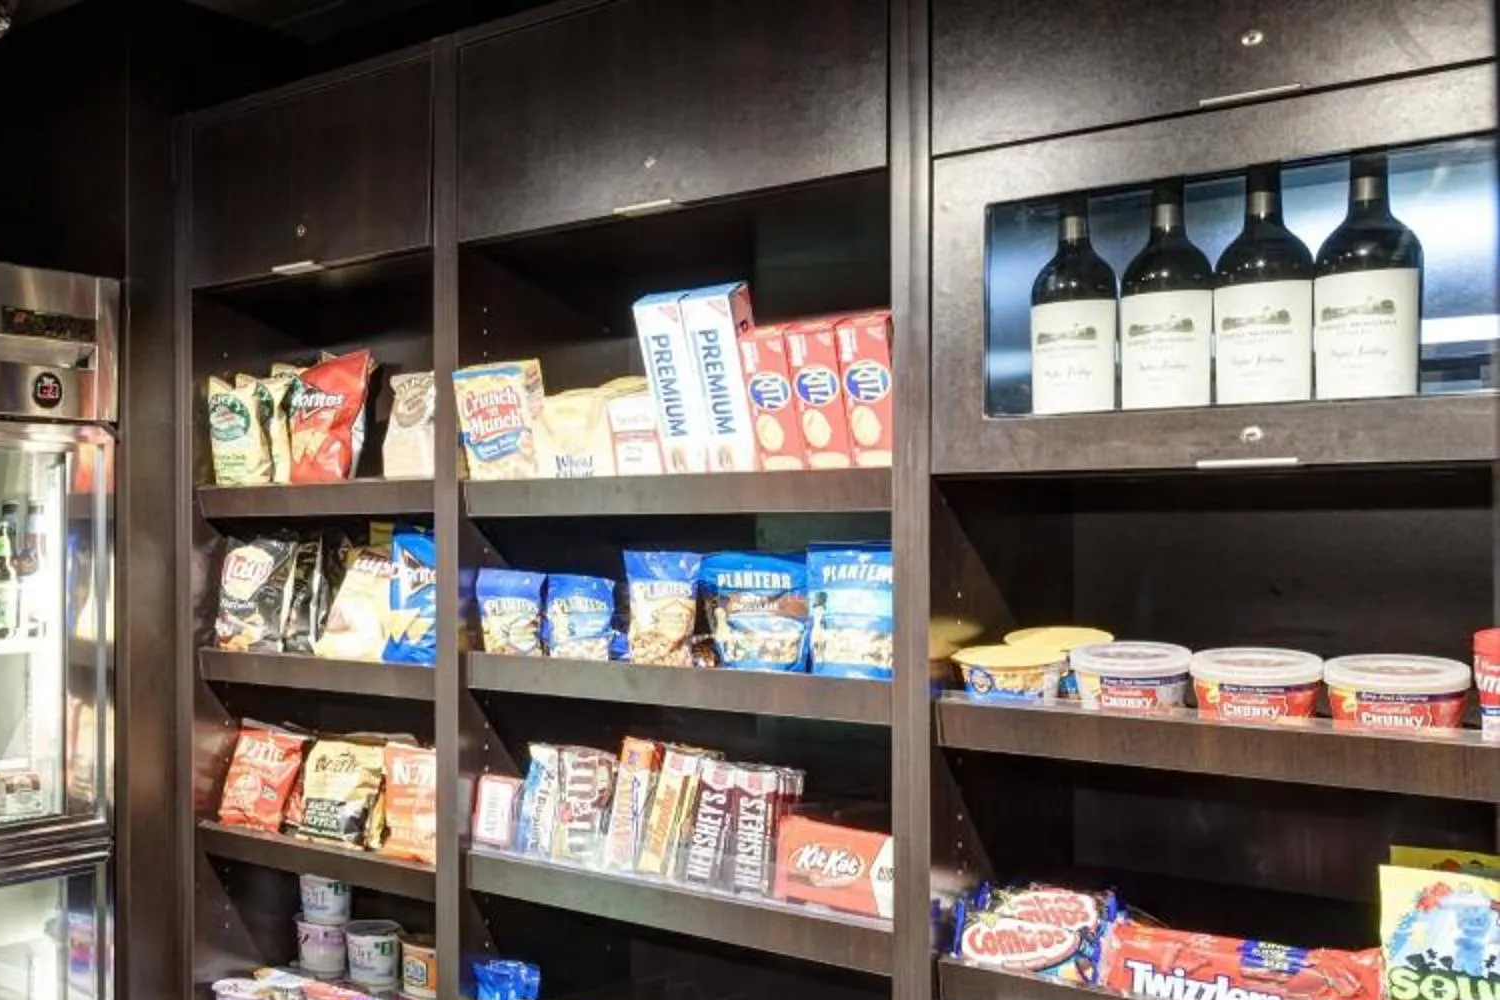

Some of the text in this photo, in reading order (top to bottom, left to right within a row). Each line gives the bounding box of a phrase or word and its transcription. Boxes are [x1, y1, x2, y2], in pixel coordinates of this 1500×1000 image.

[462, 386, 519, 418] Crunch
[651, 334, 687, 438] PREMIUM
[698, 329, 737, 435] PREMIUM
[717, 572, 793, 590] PLANTERS
[687, 790, 727, 879] HERSHEY'S
[967, 926, 1067, 956] Combos
